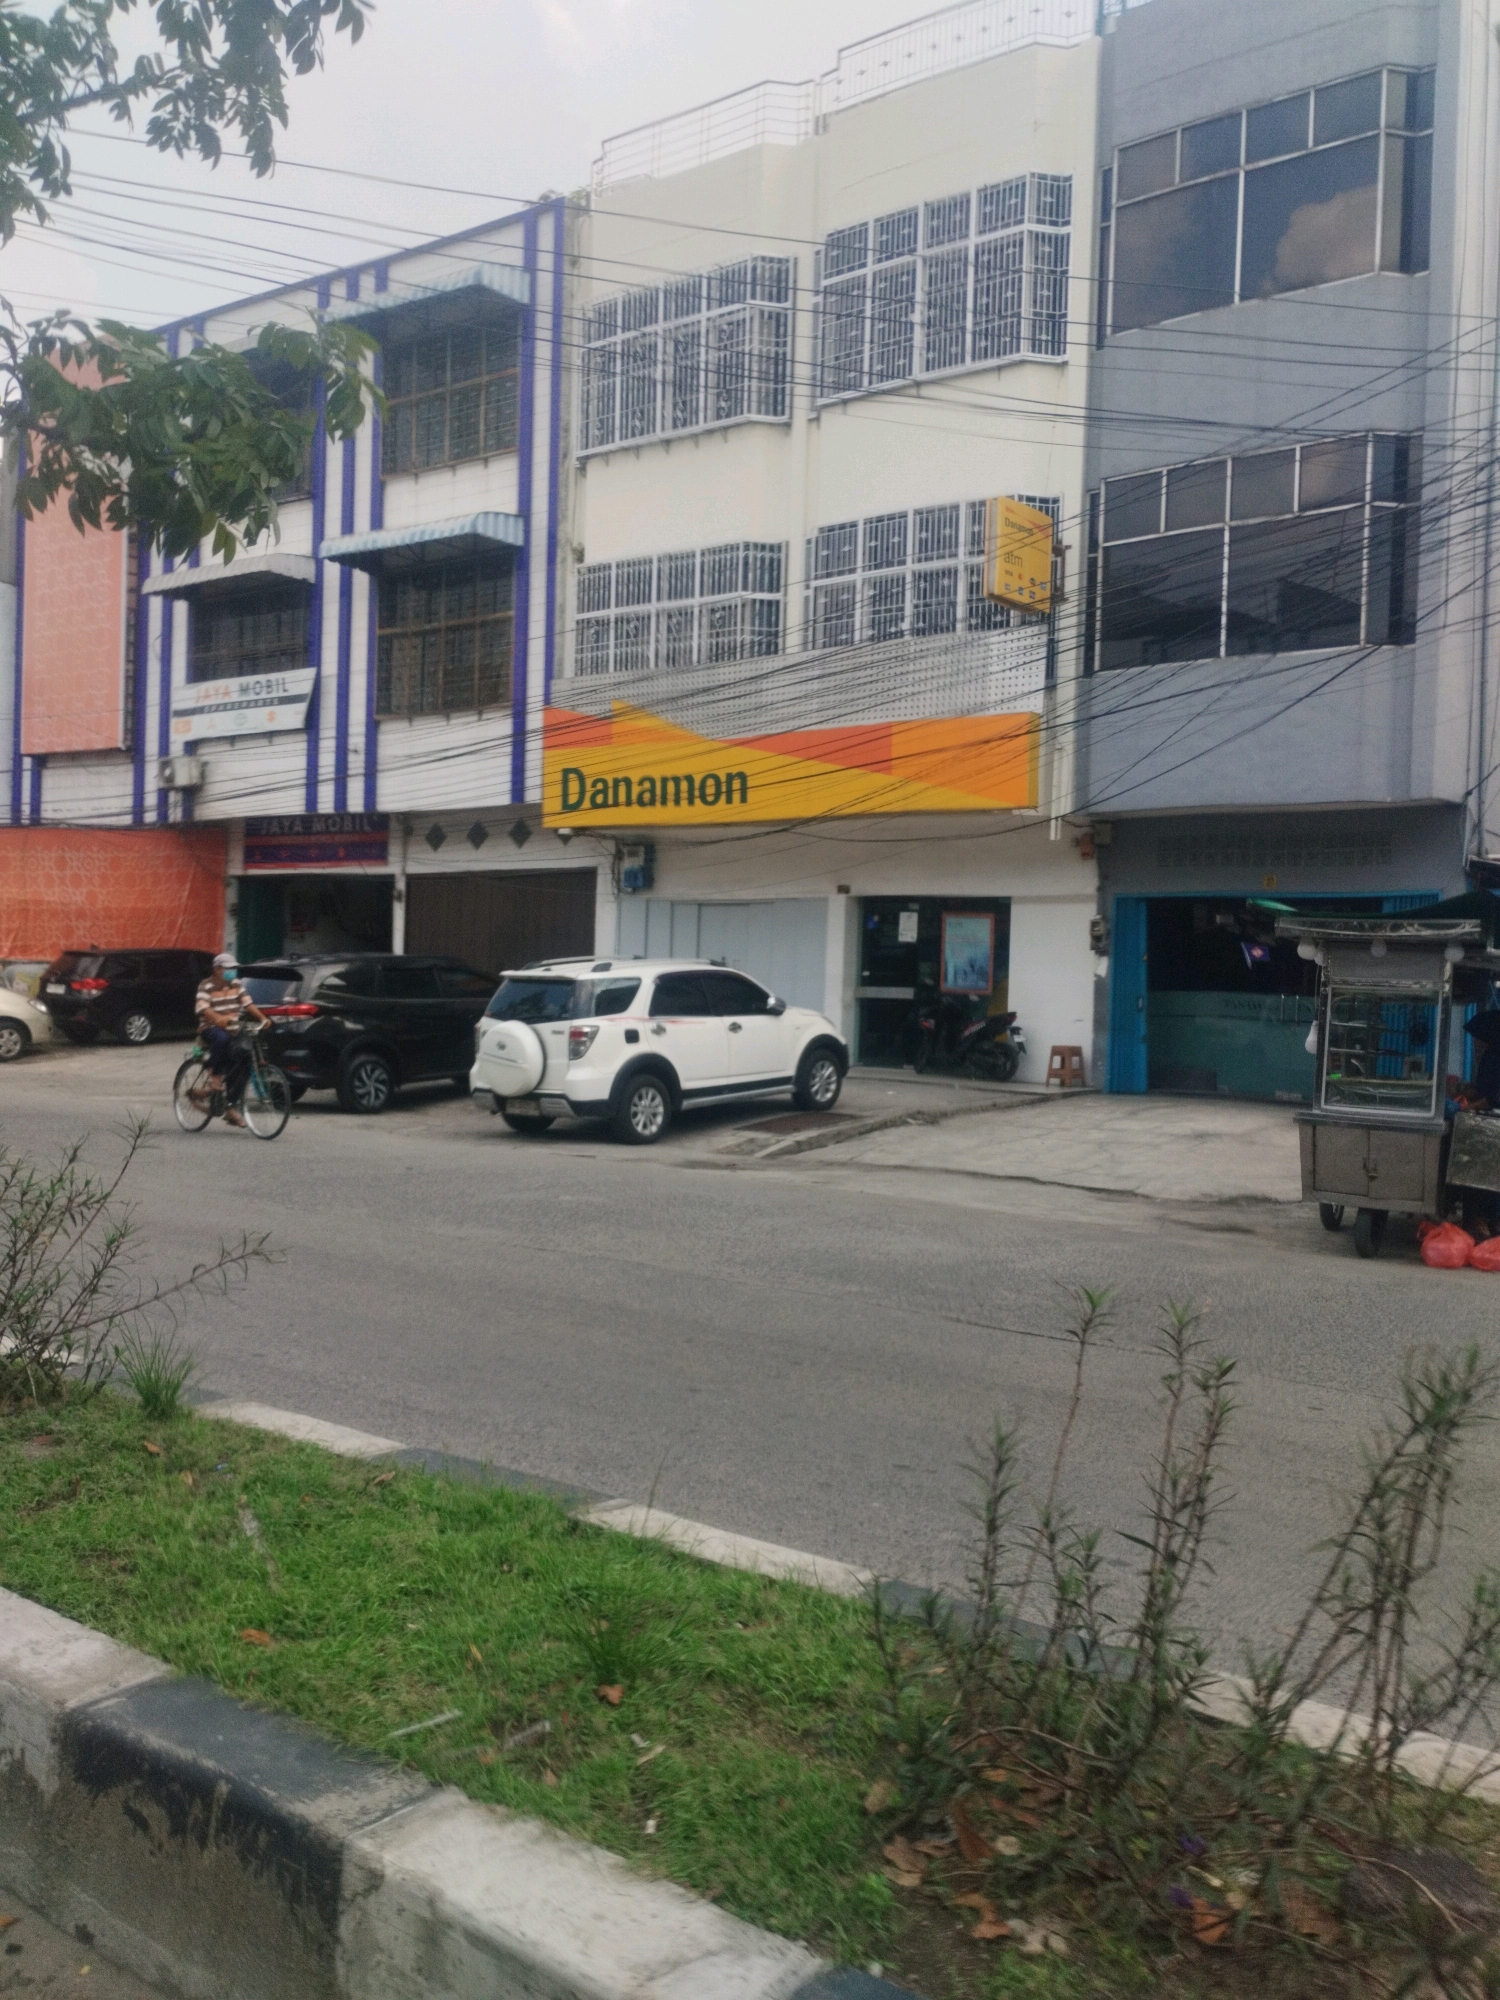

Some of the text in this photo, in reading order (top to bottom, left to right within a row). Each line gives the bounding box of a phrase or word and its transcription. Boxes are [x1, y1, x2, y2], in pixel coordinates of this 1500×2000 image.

[1003, 551, 1023, 568] atm
[195, 677, 290, 704] JAYA MOBIL
[561, 767, 748, 811] Danamon
[260, 814, 372, 835] JAYA MOBIL
